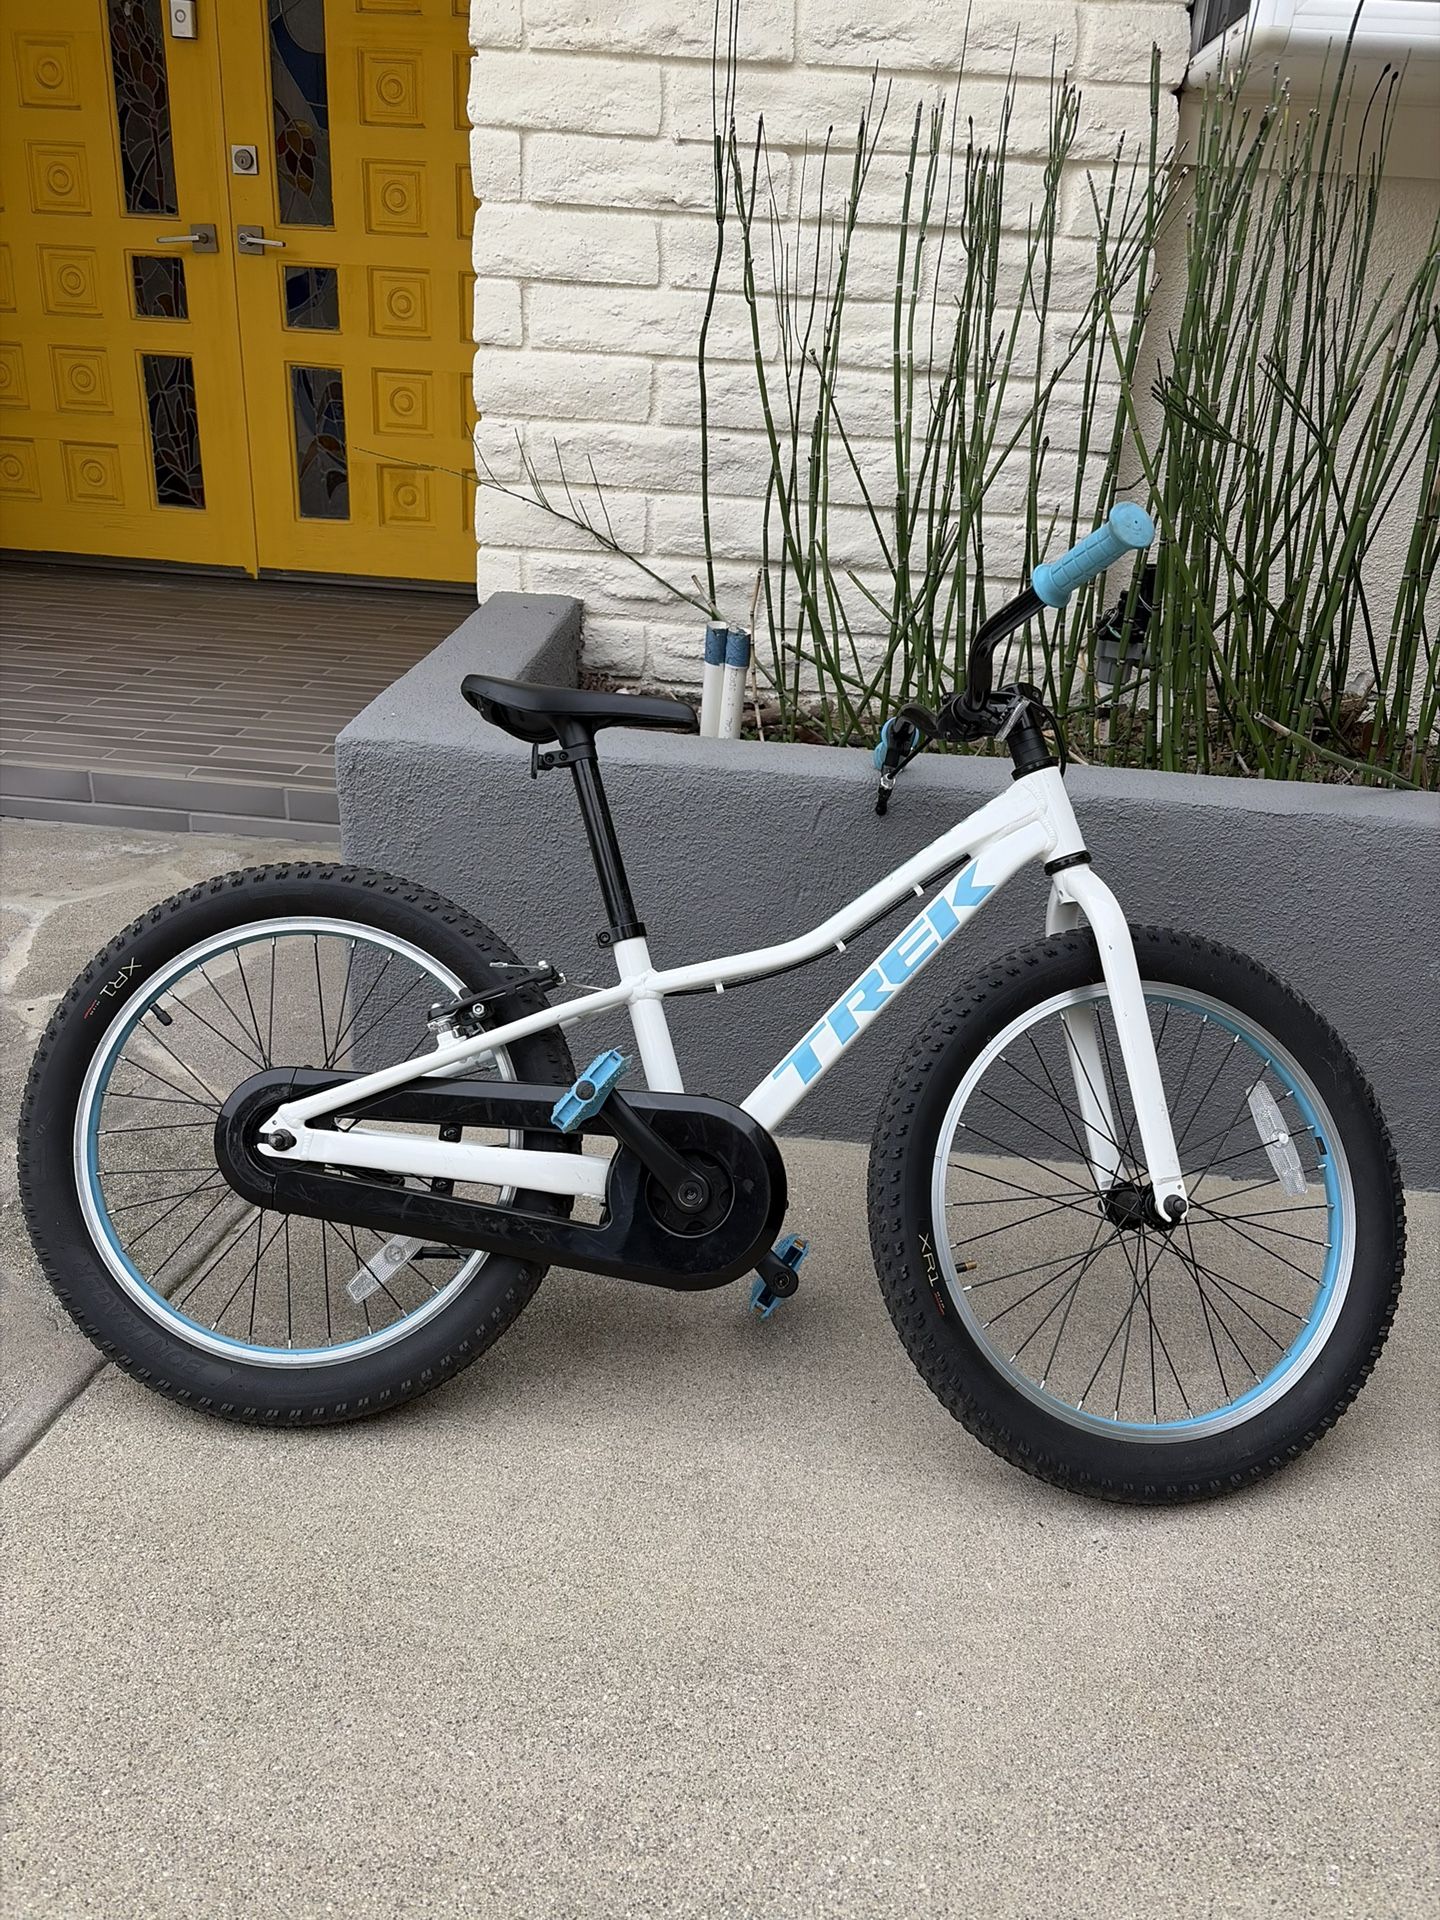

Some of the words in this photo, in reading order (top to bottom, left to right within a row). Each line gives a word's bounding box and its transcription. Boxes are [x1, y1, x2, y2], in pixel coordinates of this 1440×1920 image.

[99, 957, 142, 997] XR1
[772, 859, 996, 1085] TREK
[918, 1233, 939, 1287] XR1
